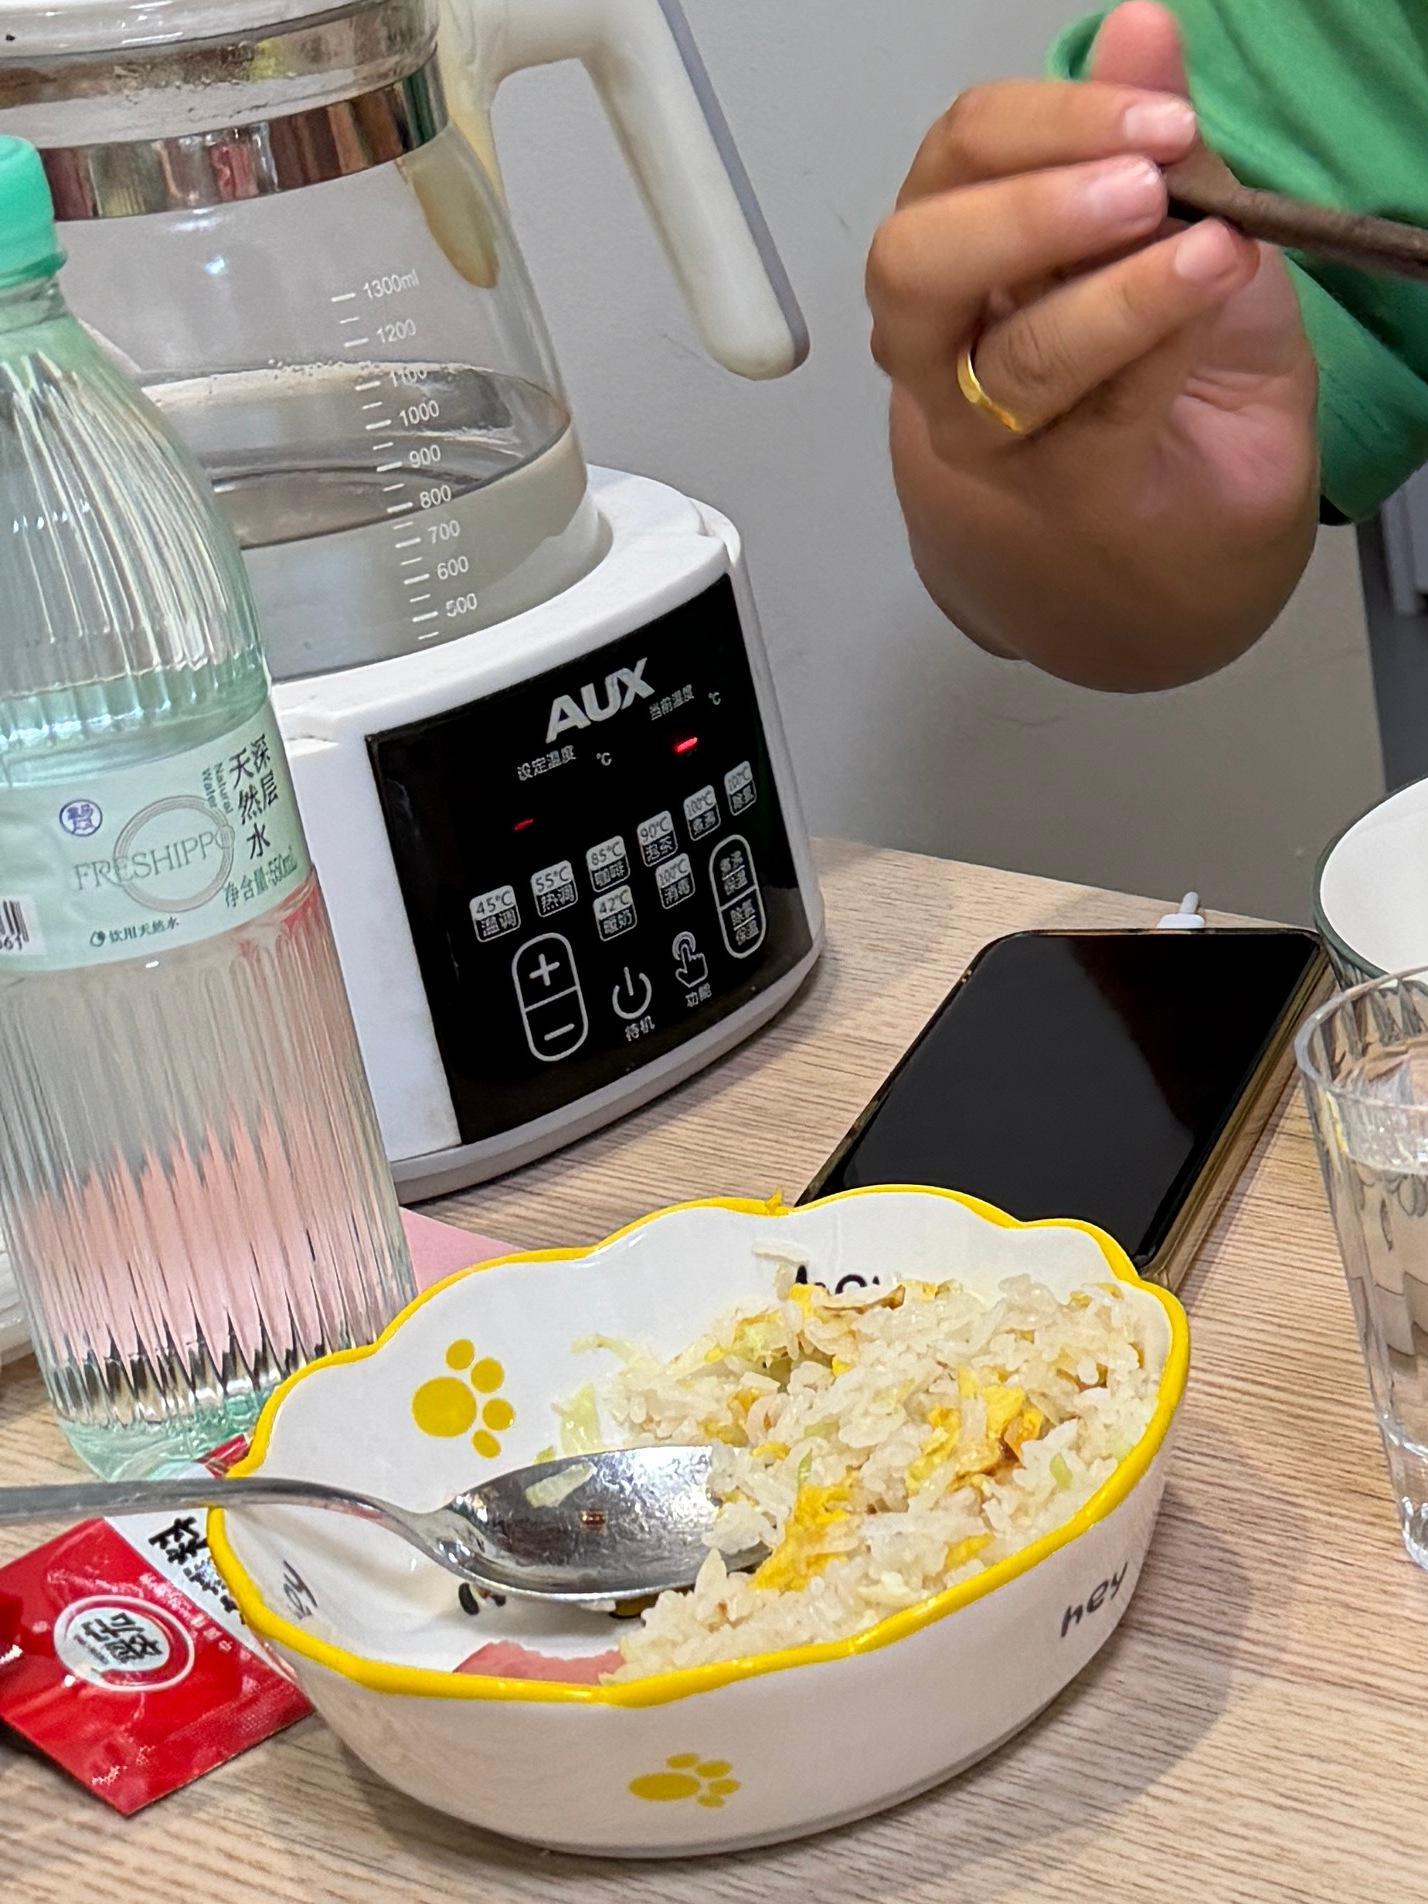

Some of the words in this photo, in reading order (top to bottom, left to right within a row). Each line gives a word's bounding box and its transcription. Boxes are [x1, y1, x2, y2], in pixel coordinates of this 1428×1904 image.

[363, 269, 420, 300] 1300ml
[376, 319, 417, 344] 1200
[399, 400, 440, 427] 1000
[409, 445, 442, 469] 900
[419, 484, 453, 509] 800
[428, 520, 461, 545] 700
[436, 556, 470, 580] 600
[445, 593, 478, 617] 500
[545, 657, 655, 744] AUX
[517, 745, 577, 781] 设定温度
[229, 748, 271, 860] 天然水
[1061, 1561, 1128, 1638] hey
